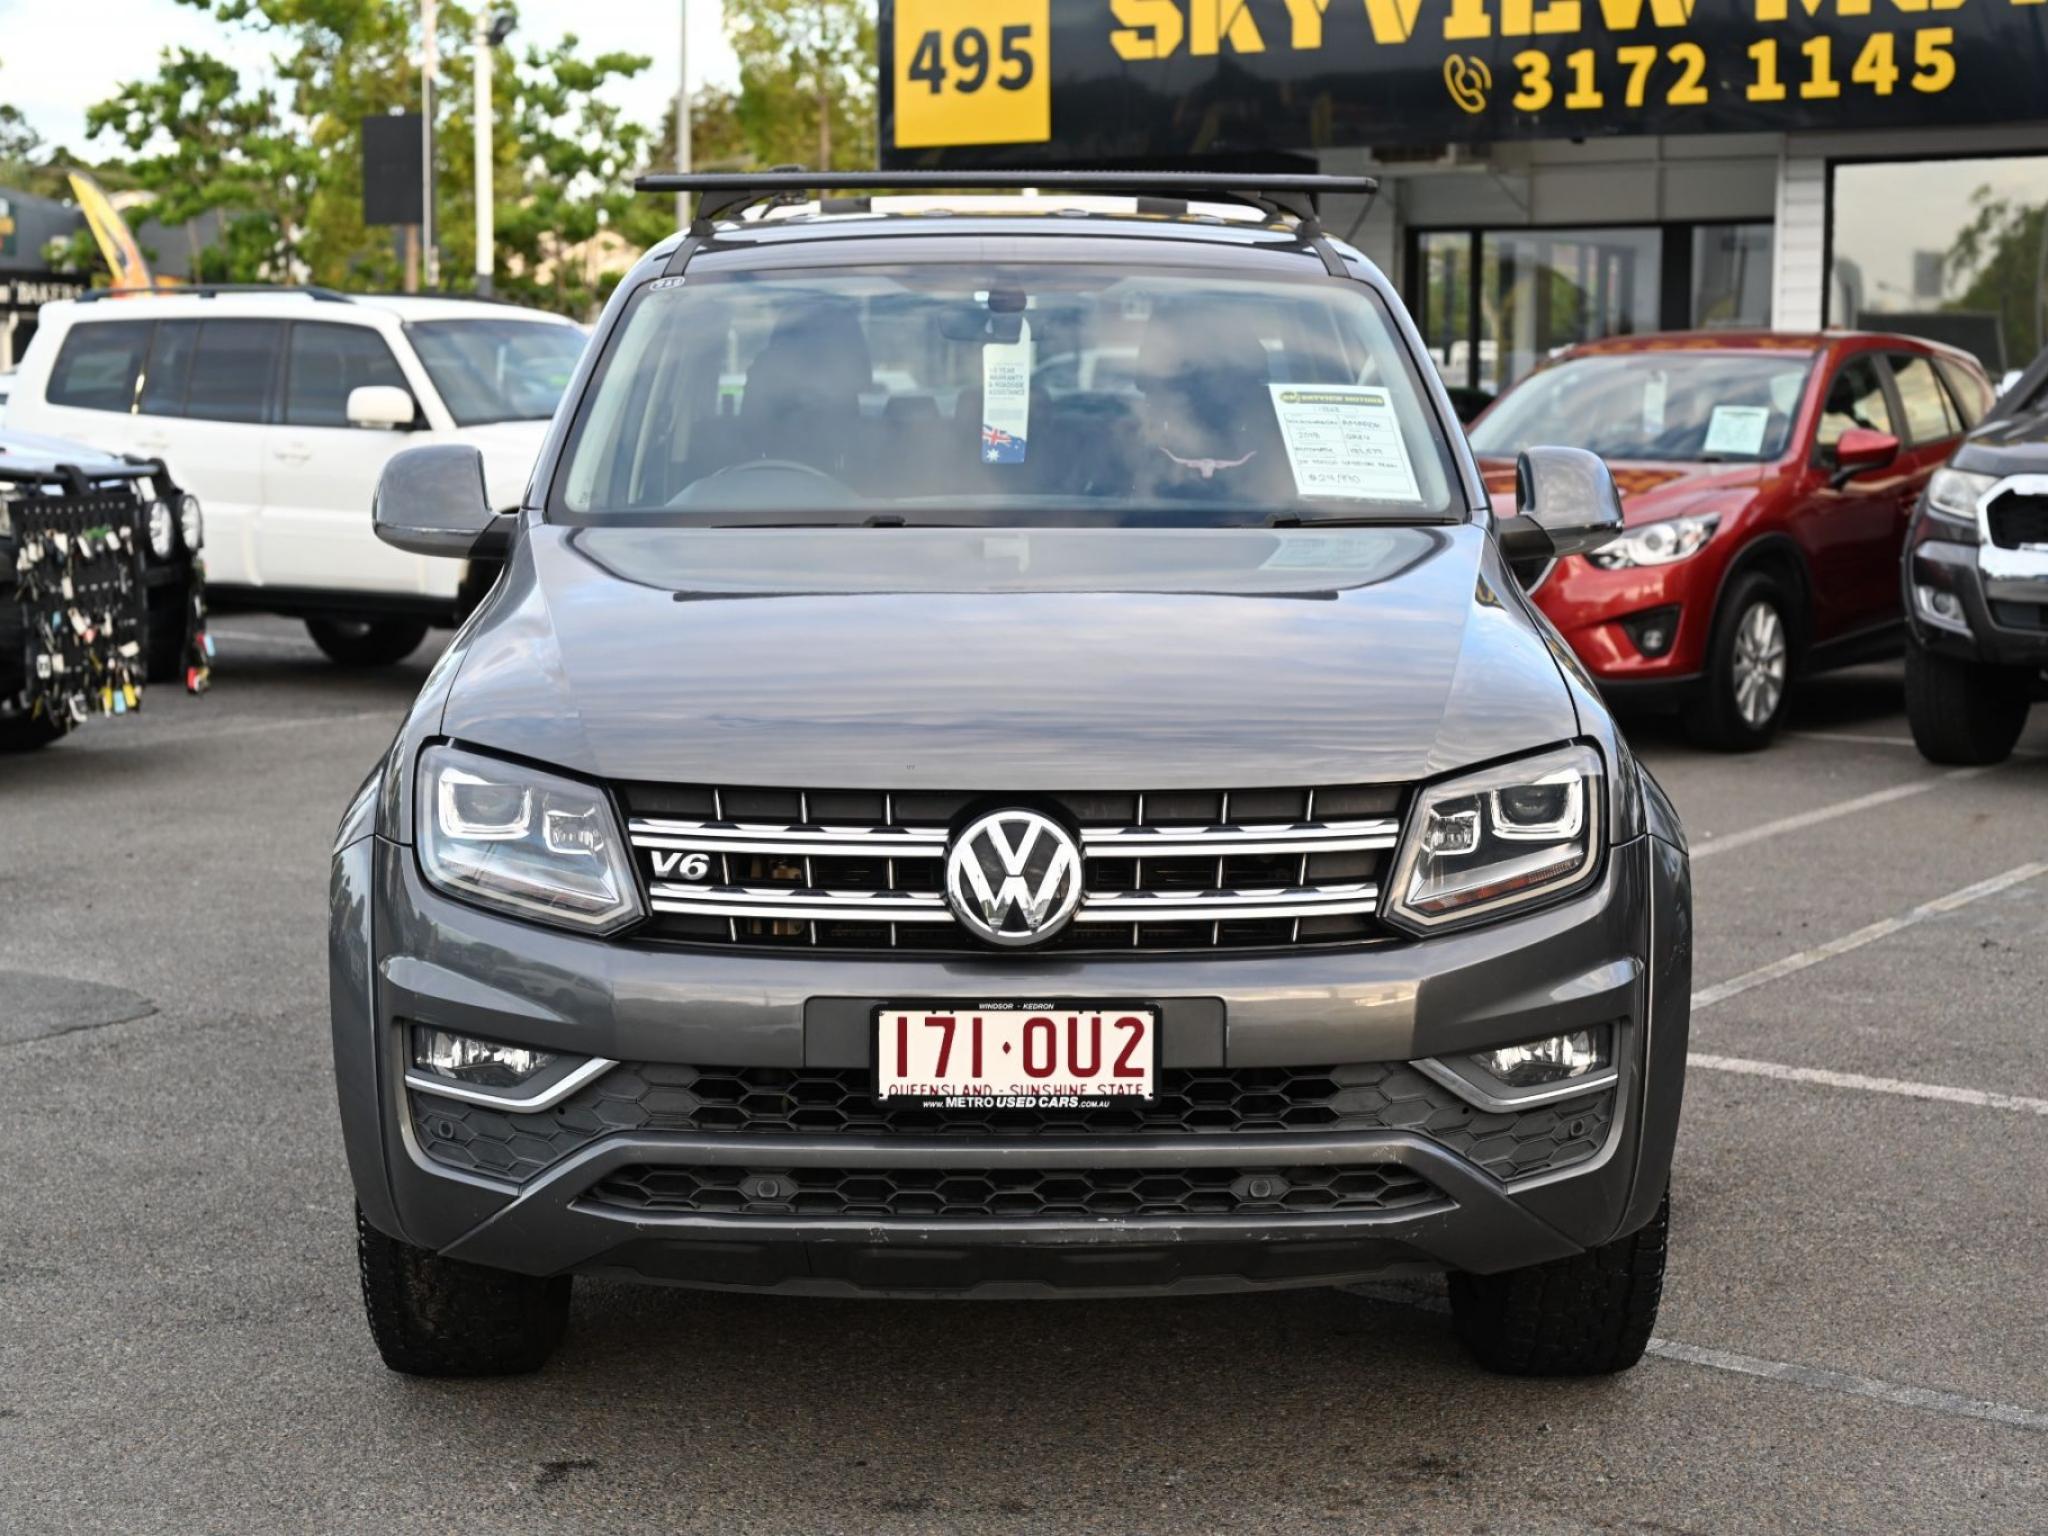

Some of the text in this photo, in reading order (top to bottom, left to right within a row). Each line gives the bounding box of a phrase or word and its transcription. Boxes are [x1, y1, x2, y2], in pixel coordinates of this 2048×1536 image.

[908, 25, 1034, 94] 495
[1511, 27, 1956, 111] 3172 1145
[650, 850, 711, 881] V6
[889, 1083, 1144, 1095] QUEENSLAND SUNSHINE STATE
